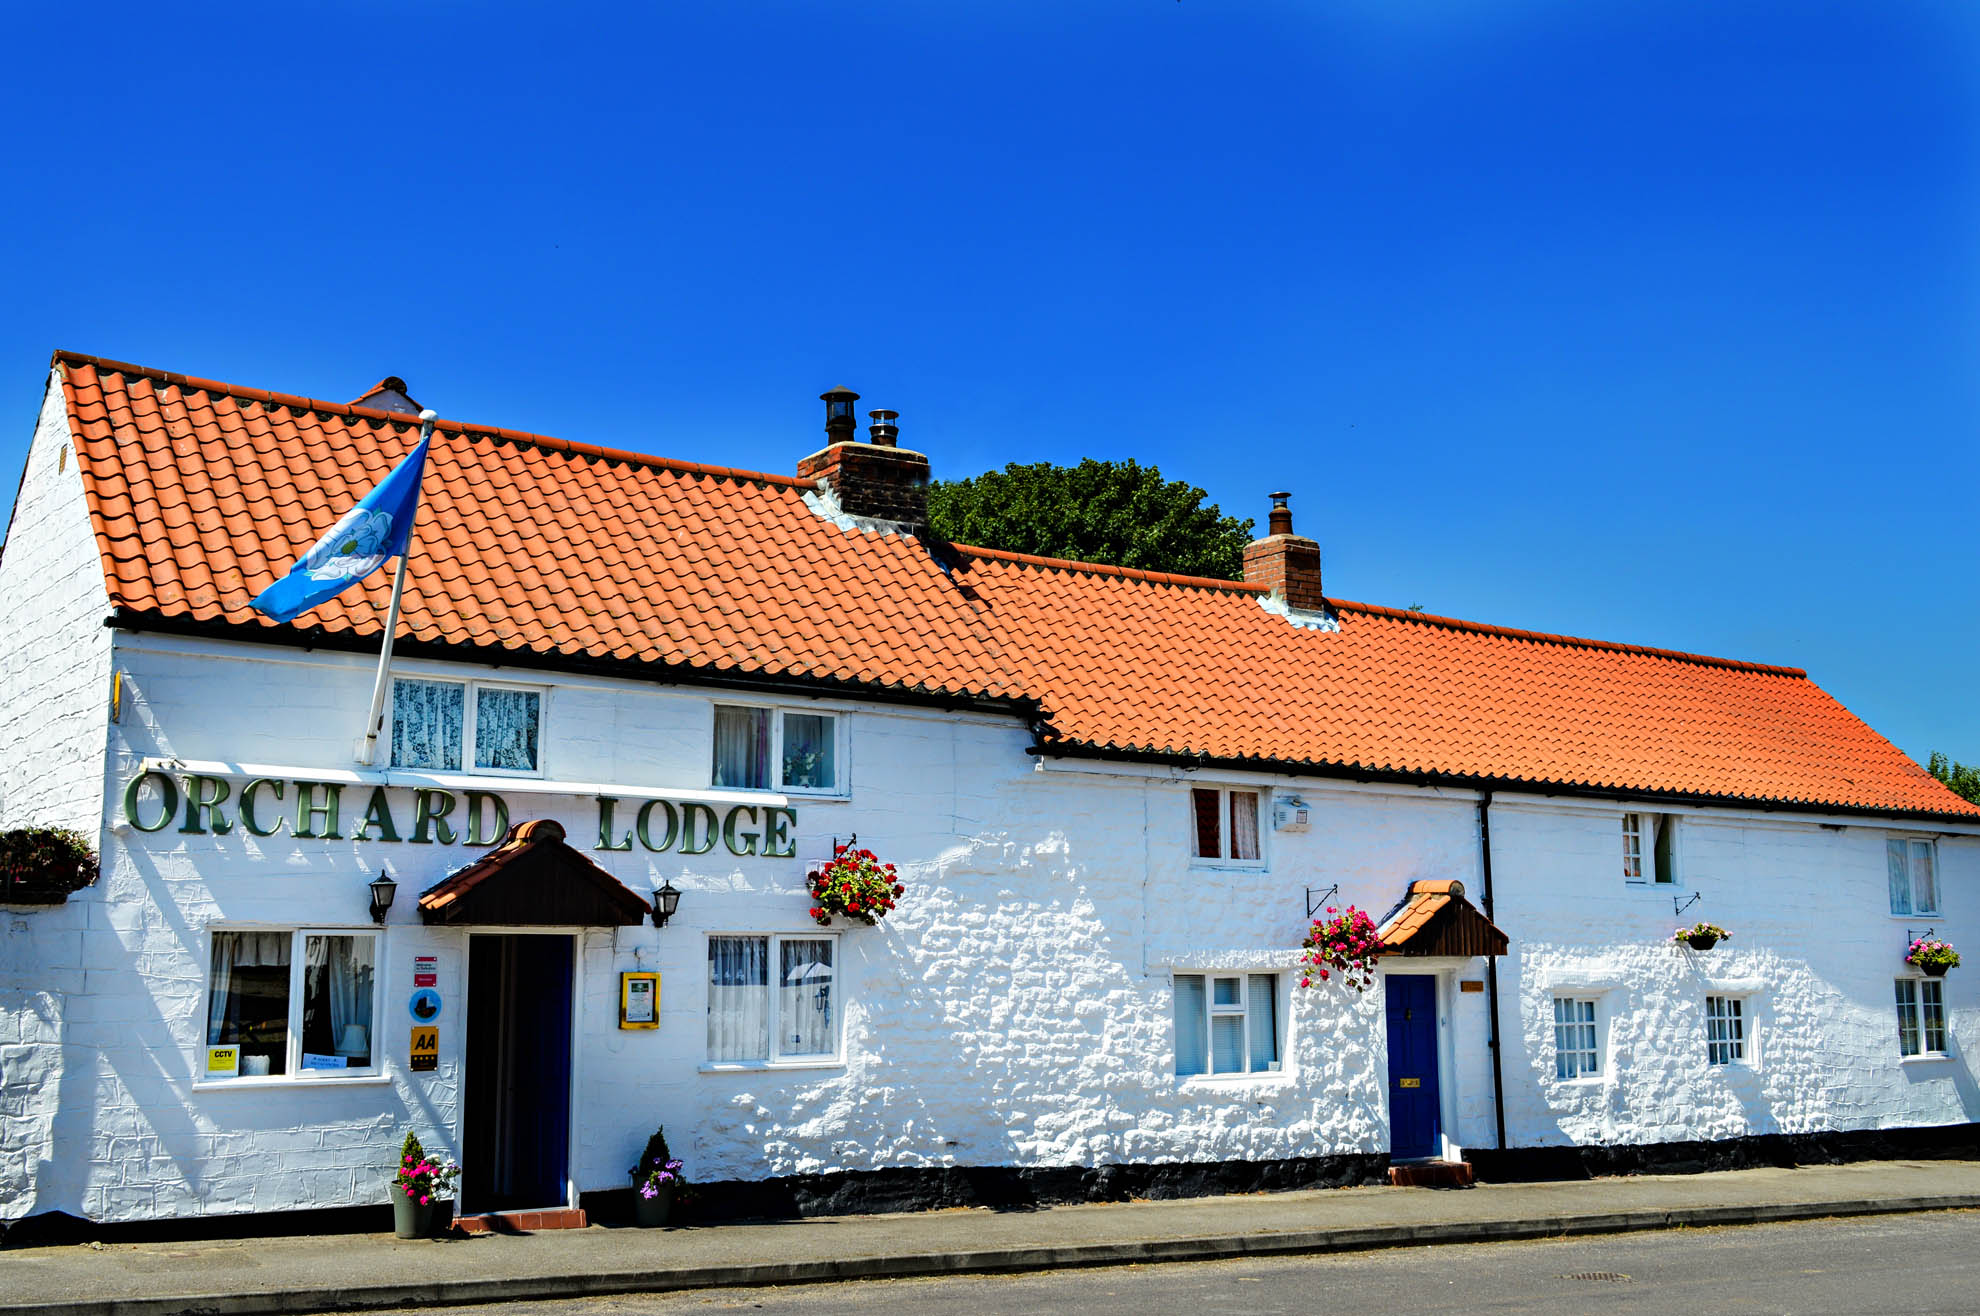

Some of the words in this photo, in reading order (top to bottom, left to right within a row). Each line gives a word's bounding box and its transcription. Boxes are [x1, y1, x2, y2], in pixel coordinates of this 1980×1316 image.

[124, 771, 510, 846] ORCHARD
[593, 797, 797, 858] LODGE
[415, 1034, 435, 1050] AA
[214, 1050, 233, 1058] CCTV
